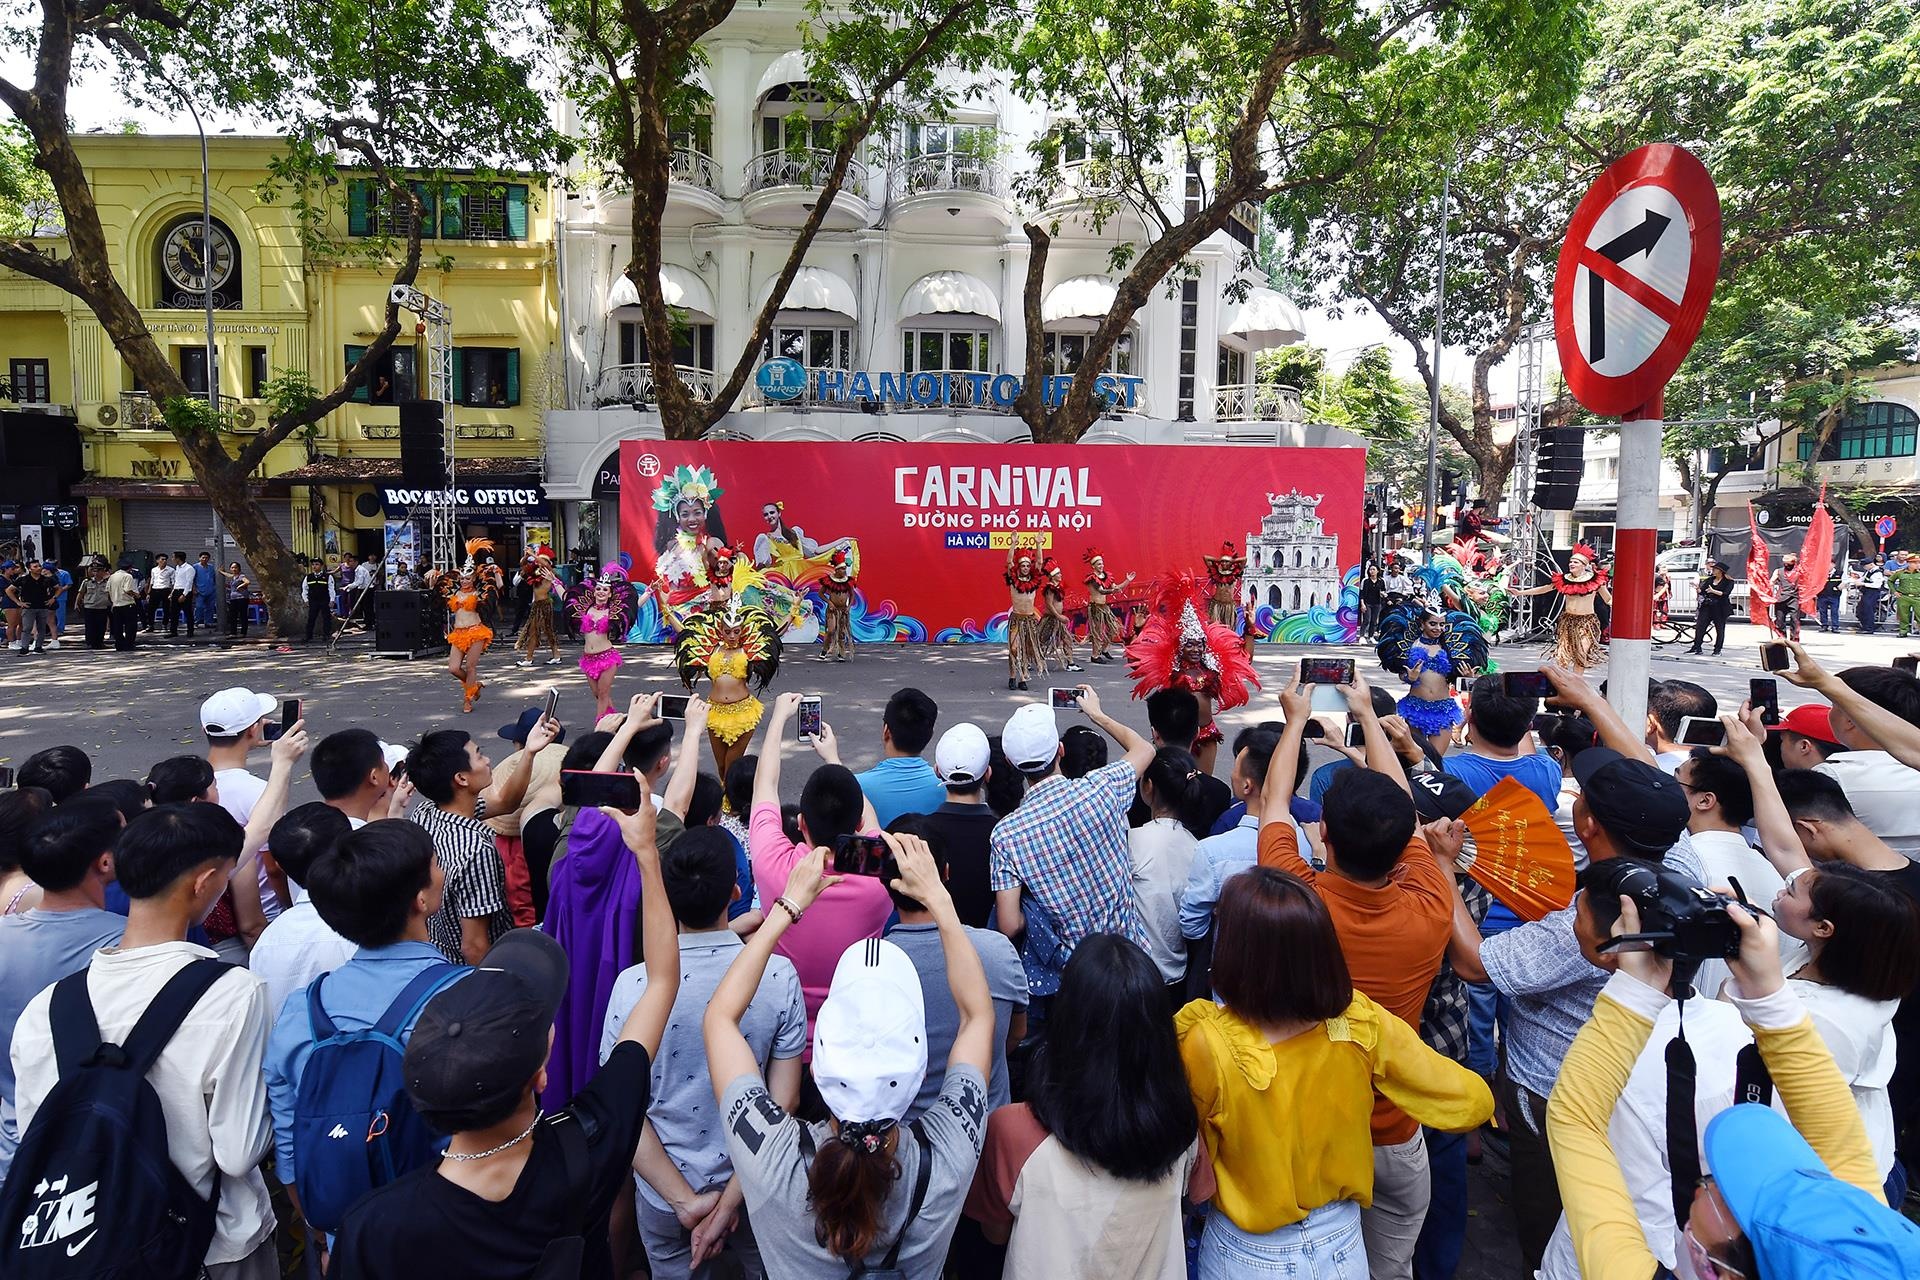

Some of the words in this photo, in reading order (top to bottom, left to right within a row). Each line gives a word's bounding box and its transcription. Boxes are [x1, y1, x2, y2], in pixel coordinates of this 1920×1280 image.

[818, 371, 951, 405] HANOI
[965, 373, 1144, 409] TORST
[130, 460, 180, 477] NEW
[601, 471, 620, 485] PA
[474, 489, 539, 505] OFFICE
[495, 506, 527, 515] CENTRE
[903, 510, 975, 528] ĐƯỜNG
[981, 508, 1020, 528] PHỐ
[1026, 510, 1052, 528] HÀ
[1058, 510, 1092, 532] NỘI
[947, 533, 964, 546] HÀ
[966, 533, 987, 549] NỘI
[992, 536, 1047, 546] 19.0.209
[19, 1180, 99, 1250] NIKE
